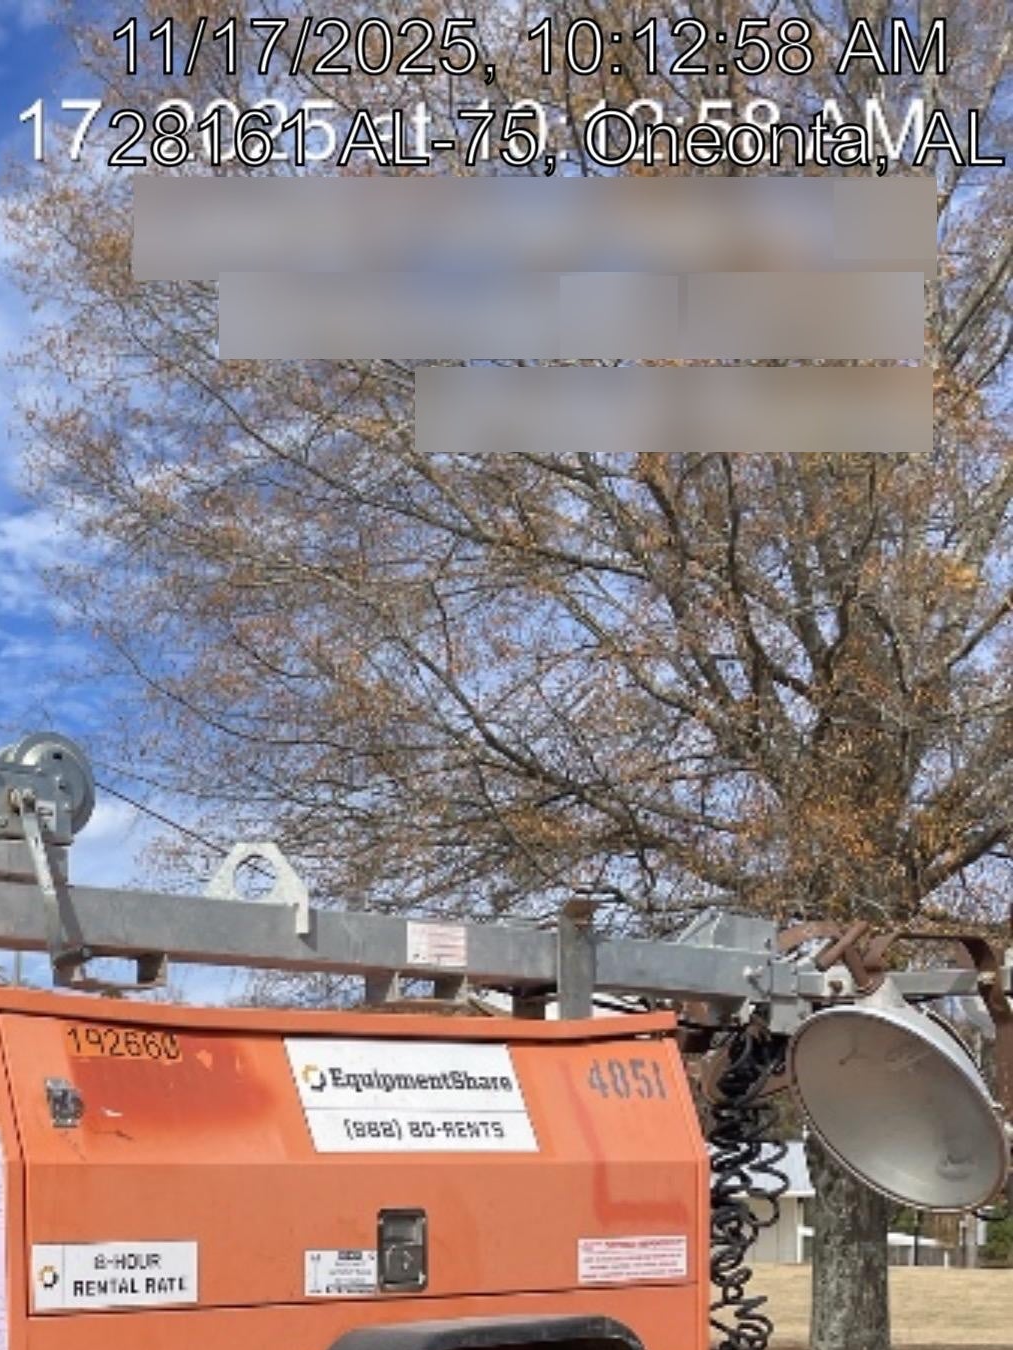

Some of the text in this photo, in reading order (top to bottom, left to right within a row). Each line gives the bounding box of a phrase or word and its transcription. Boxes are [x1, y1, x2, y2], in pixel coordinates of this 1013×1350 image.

[328, 1067, 513, 1093] EquipmentShare
[343, 1118, 506, 1141] (888) 80-RENTS
[94, 1252, 162, 1271] 8-HOUR
[73, 1275, 189, 1298] RENTAL RATE
